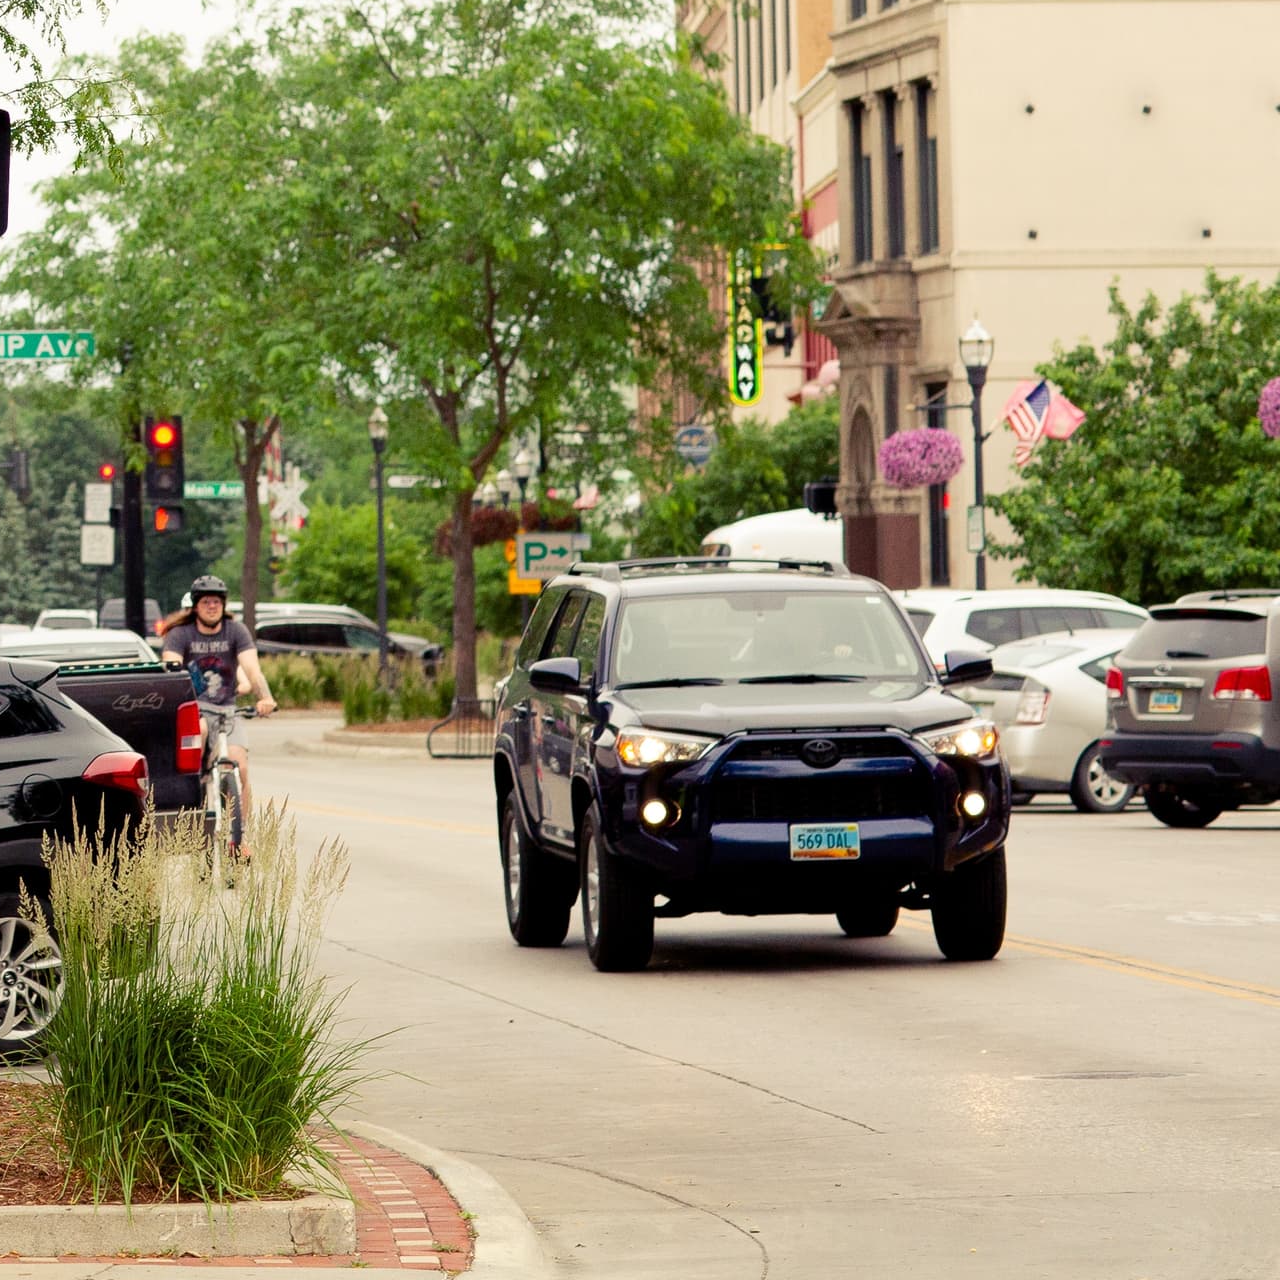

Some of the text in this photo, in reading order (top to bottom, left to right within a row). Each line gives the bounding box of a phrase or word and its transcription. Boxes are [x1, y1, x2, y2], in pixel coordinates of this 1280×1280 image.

[524, 541, 548, 572] P
[797, 832, 852, 849] 569 DAL
